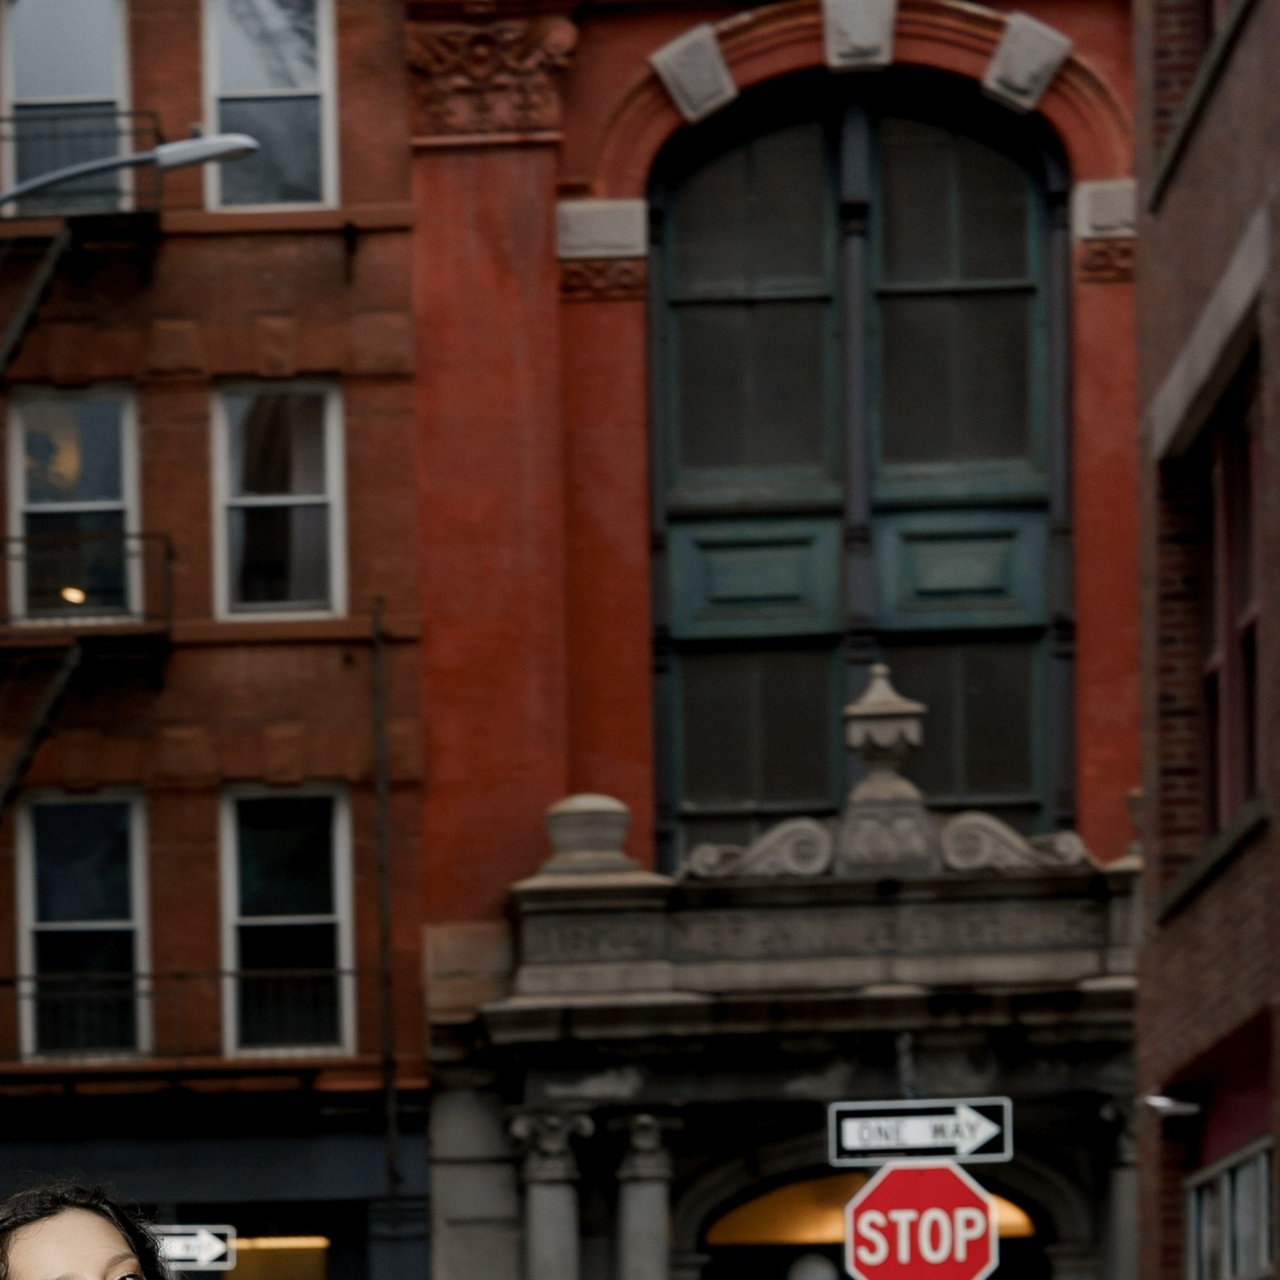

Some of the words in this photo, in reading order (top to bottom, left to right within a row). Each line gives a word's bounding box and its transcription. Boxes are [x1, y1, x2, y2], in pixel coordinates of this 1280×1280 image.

[858, 1122, 901, 1143] ONE
[930, 1121, 978, 1140] WAY
[856, 1207, 987, 1265] STOP
